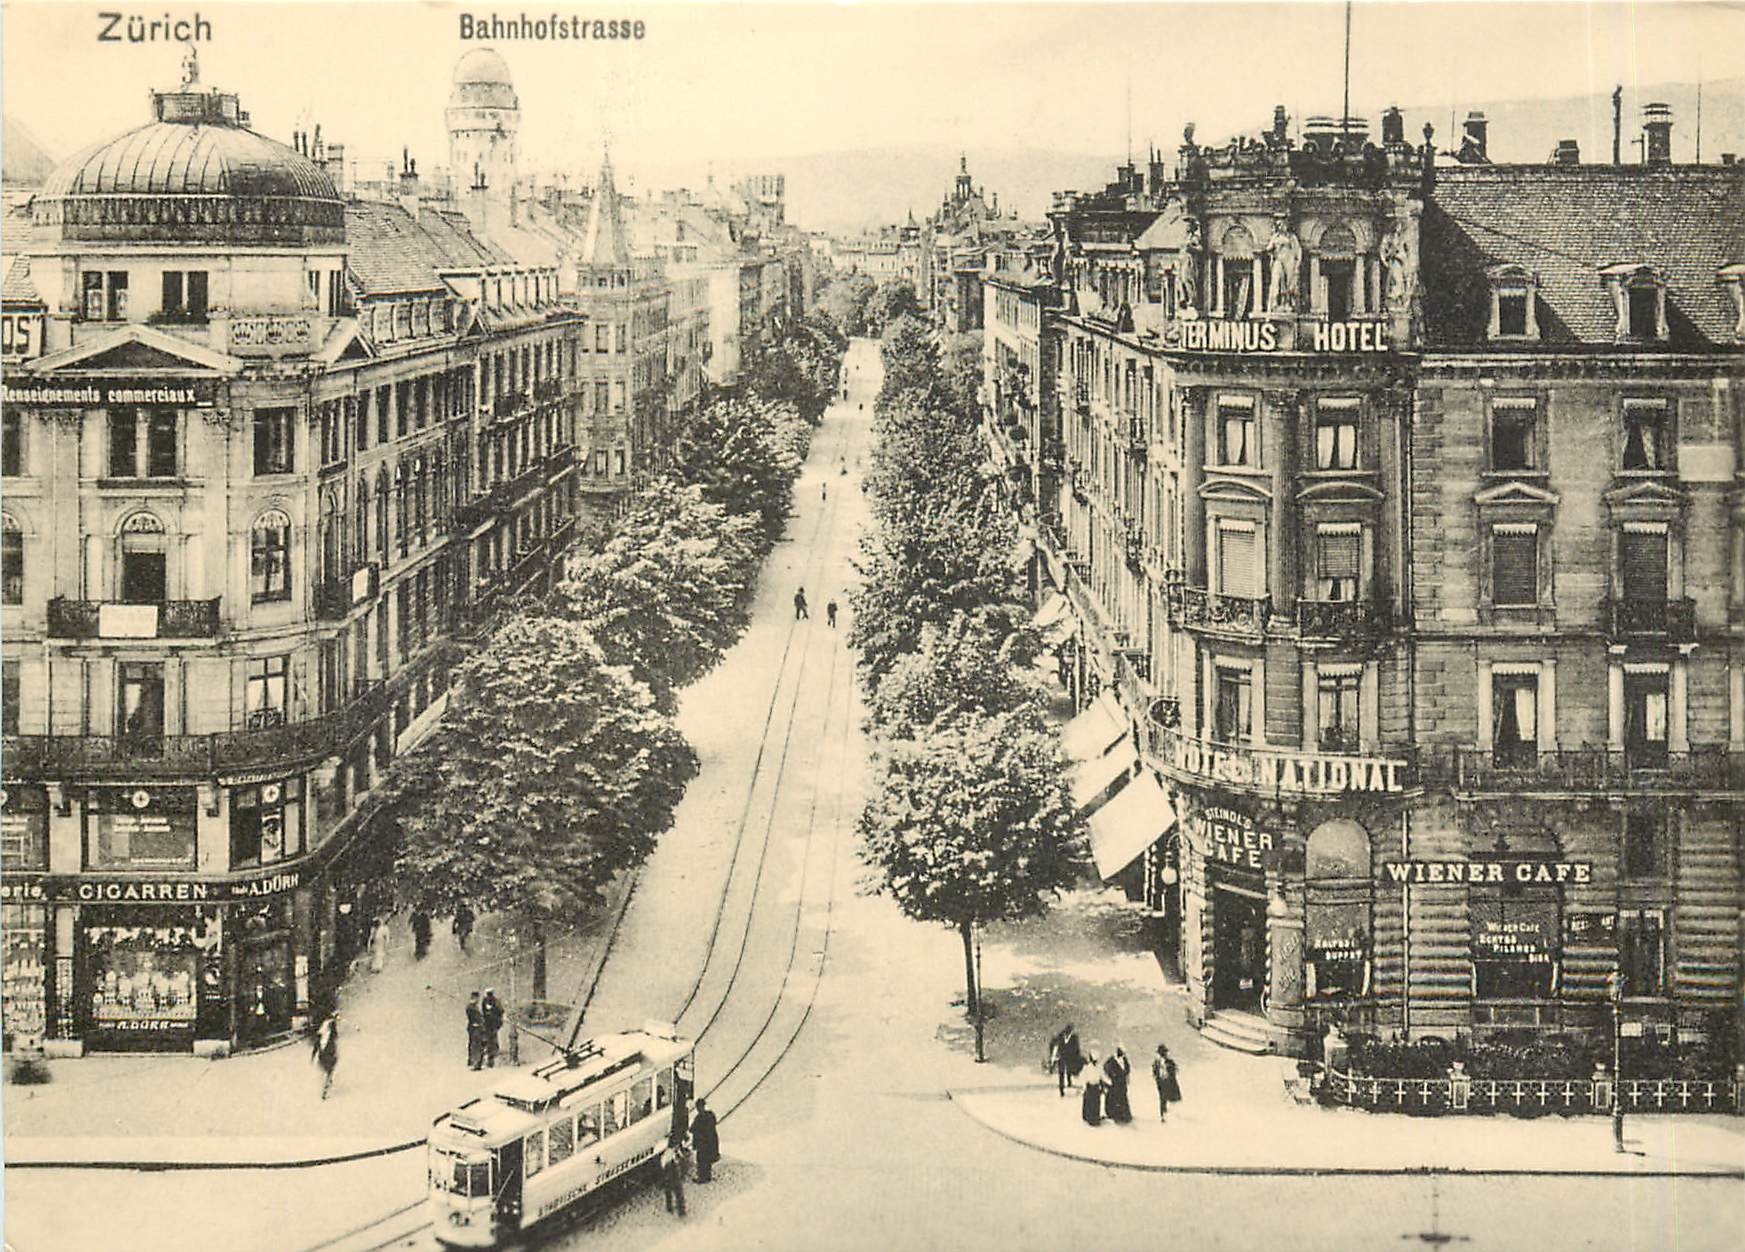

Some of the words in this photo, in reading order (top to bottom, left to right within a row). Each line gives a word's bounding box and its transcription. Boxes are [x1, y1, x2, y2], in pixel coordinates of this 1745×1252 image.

[1180, 321, 1278, 350] TERMINUS
[1314, 322, 1388, 351] HOTEL
[108, 386, 195, 402] commerciaux
[1259, 756, 1405, 792] NATIONAL
[1194, 816, 1273, 851] WIENER
[1204, 841, 1262, 869] CAFE
[1387, 863, 1504, 882] WIENER
[1516, 863, 1591, 882] CAFE
[79, 883, 207, 900] CIGARREN
